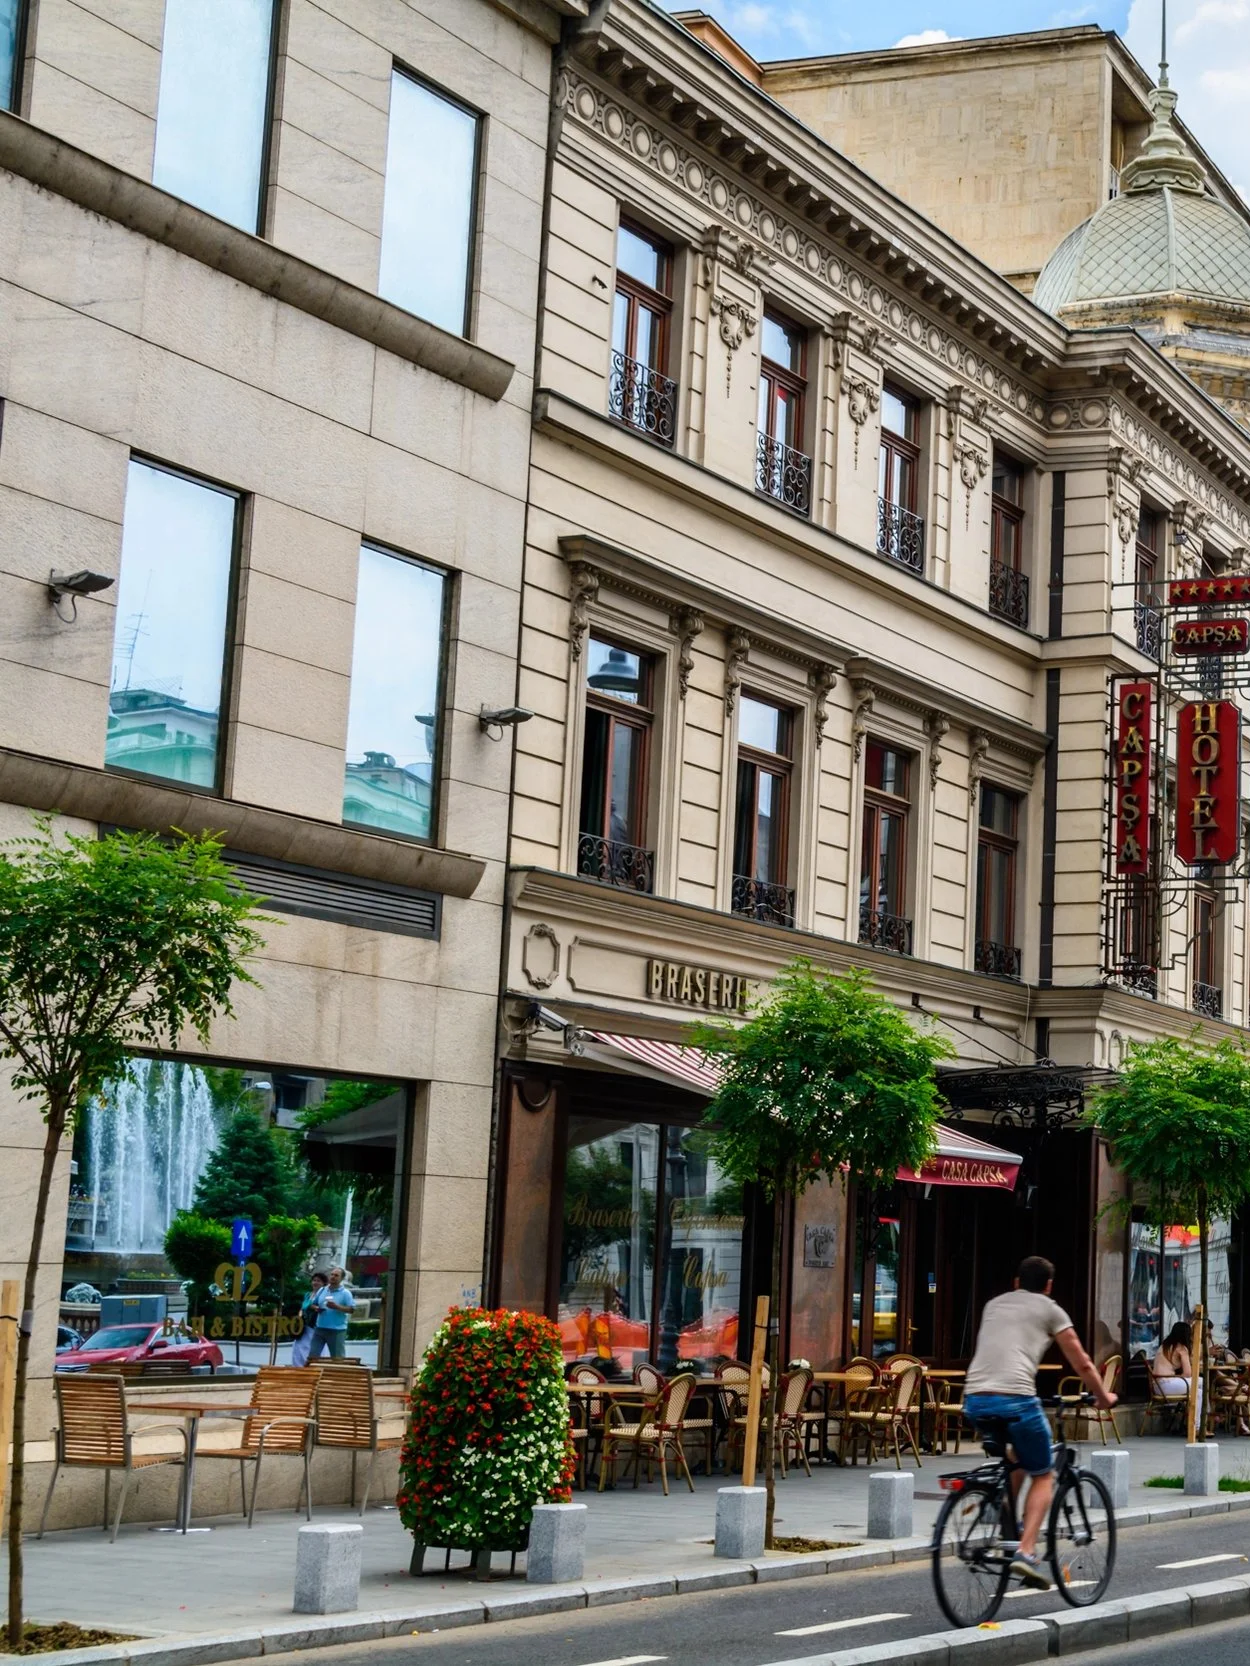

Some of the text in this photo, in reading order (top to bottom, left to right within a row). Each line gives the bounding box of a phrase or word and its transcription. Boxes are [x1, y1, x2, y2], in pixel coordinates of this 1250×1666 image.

[1191, 703, 1220, 861] HOTEL
[648, 960, 753, 1014] BRASERI
[942, 1160, 968, 1180] CASA
[210, 1316, 226, 1337] &
[231, 1315, 304, 1337] BISTRO
